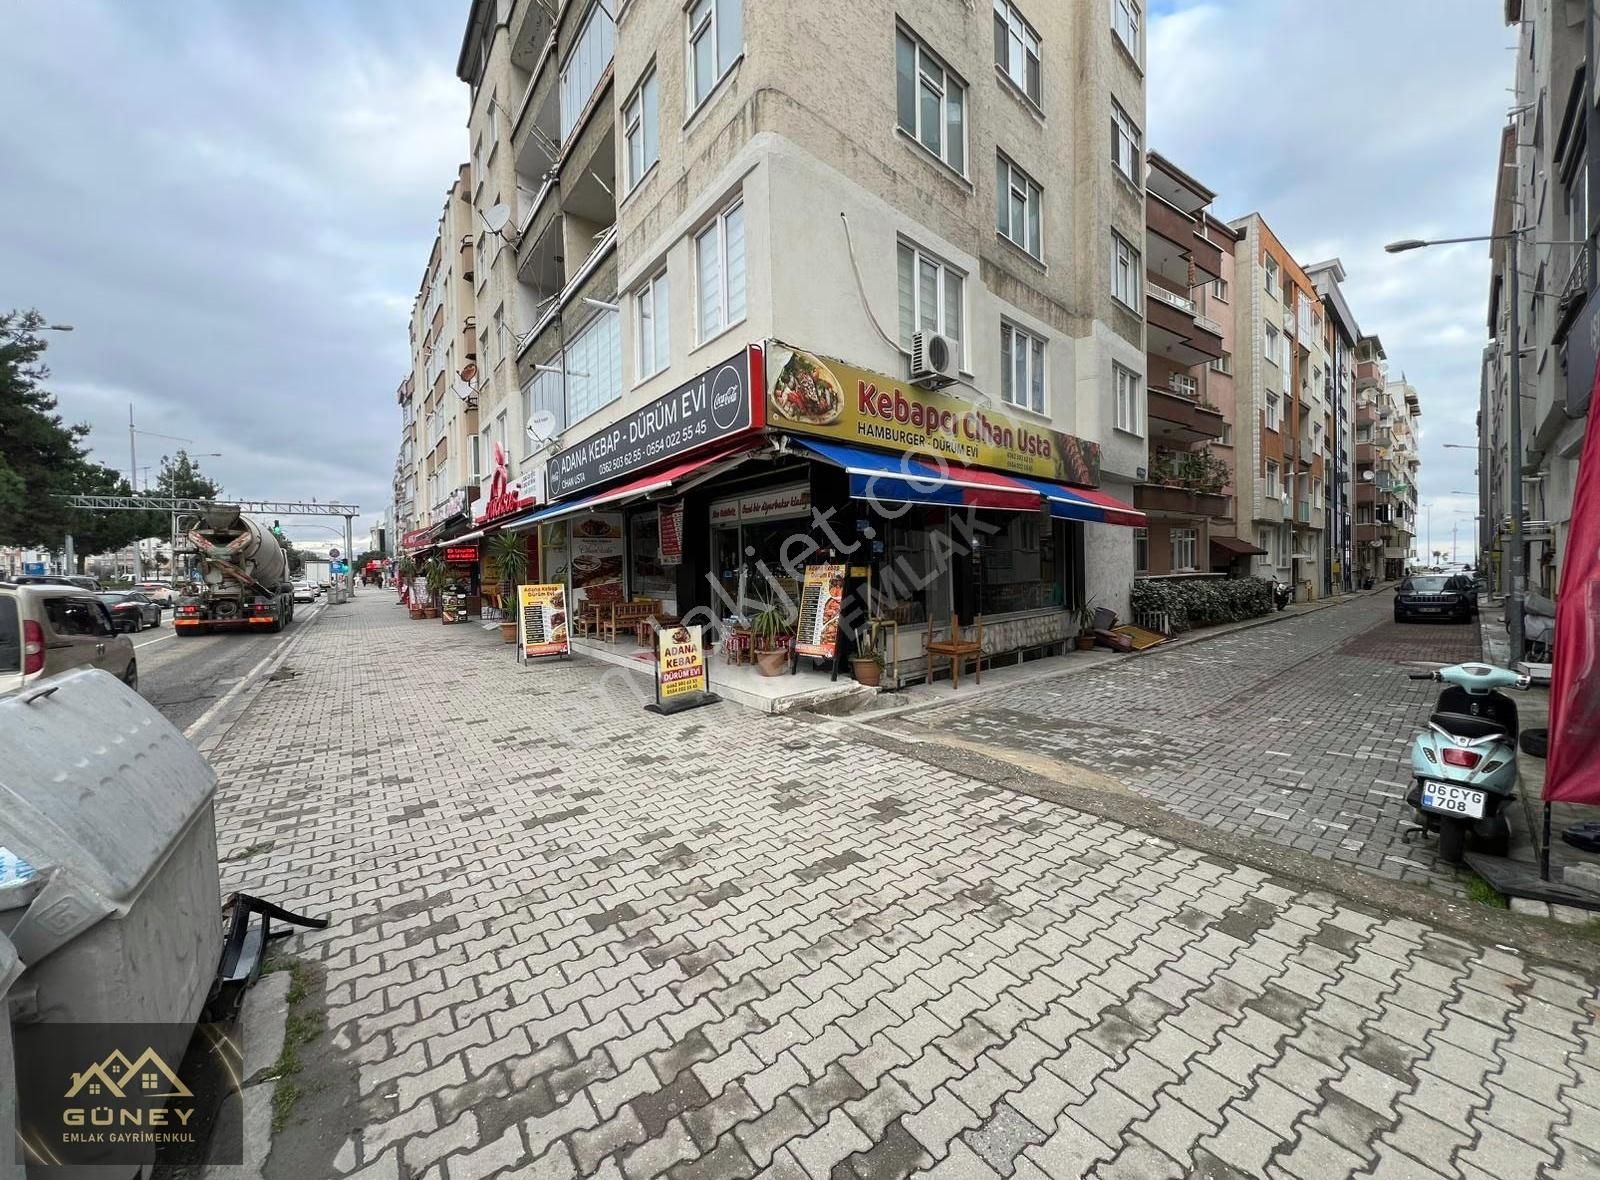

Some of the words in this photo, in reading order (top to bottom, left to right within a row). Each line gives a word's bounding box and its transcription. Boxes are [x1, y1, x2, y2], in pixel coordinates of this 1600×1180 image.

[561, 452, 587, 474] ADANA
[588, 432, 621, 462] KEBAP
[629, 399, 678, 444] DÜRÜM
[681, 376, 707, 418] EVİ
[962, 410, 1013, 450] Cihan
[1016, 426, 1051, 459] Usta
[612, 455, 624, 470] 503
[624, 452, 633, 466] 62
[632, 448, 642, 462] 55
[646, 440, 665, 456] 0554
[665, 434, 681, 449] 022
[682, 426, 694, 441] 55
[694, 419, 707, 435] 45
[857, 421, 926, 447] HAMBURGER
[966, 443, 979, 459] EVİ
[665, 644, 698, 657] ADANA
[666, 655, 697, 668] KEBAP
[663, 670, 690, 680] DÜRÜM
[1427, 783, 1447, 796] 06
[1449, 788, 1482, 804] CYG
[1436, 796, 1467, 812] 708
